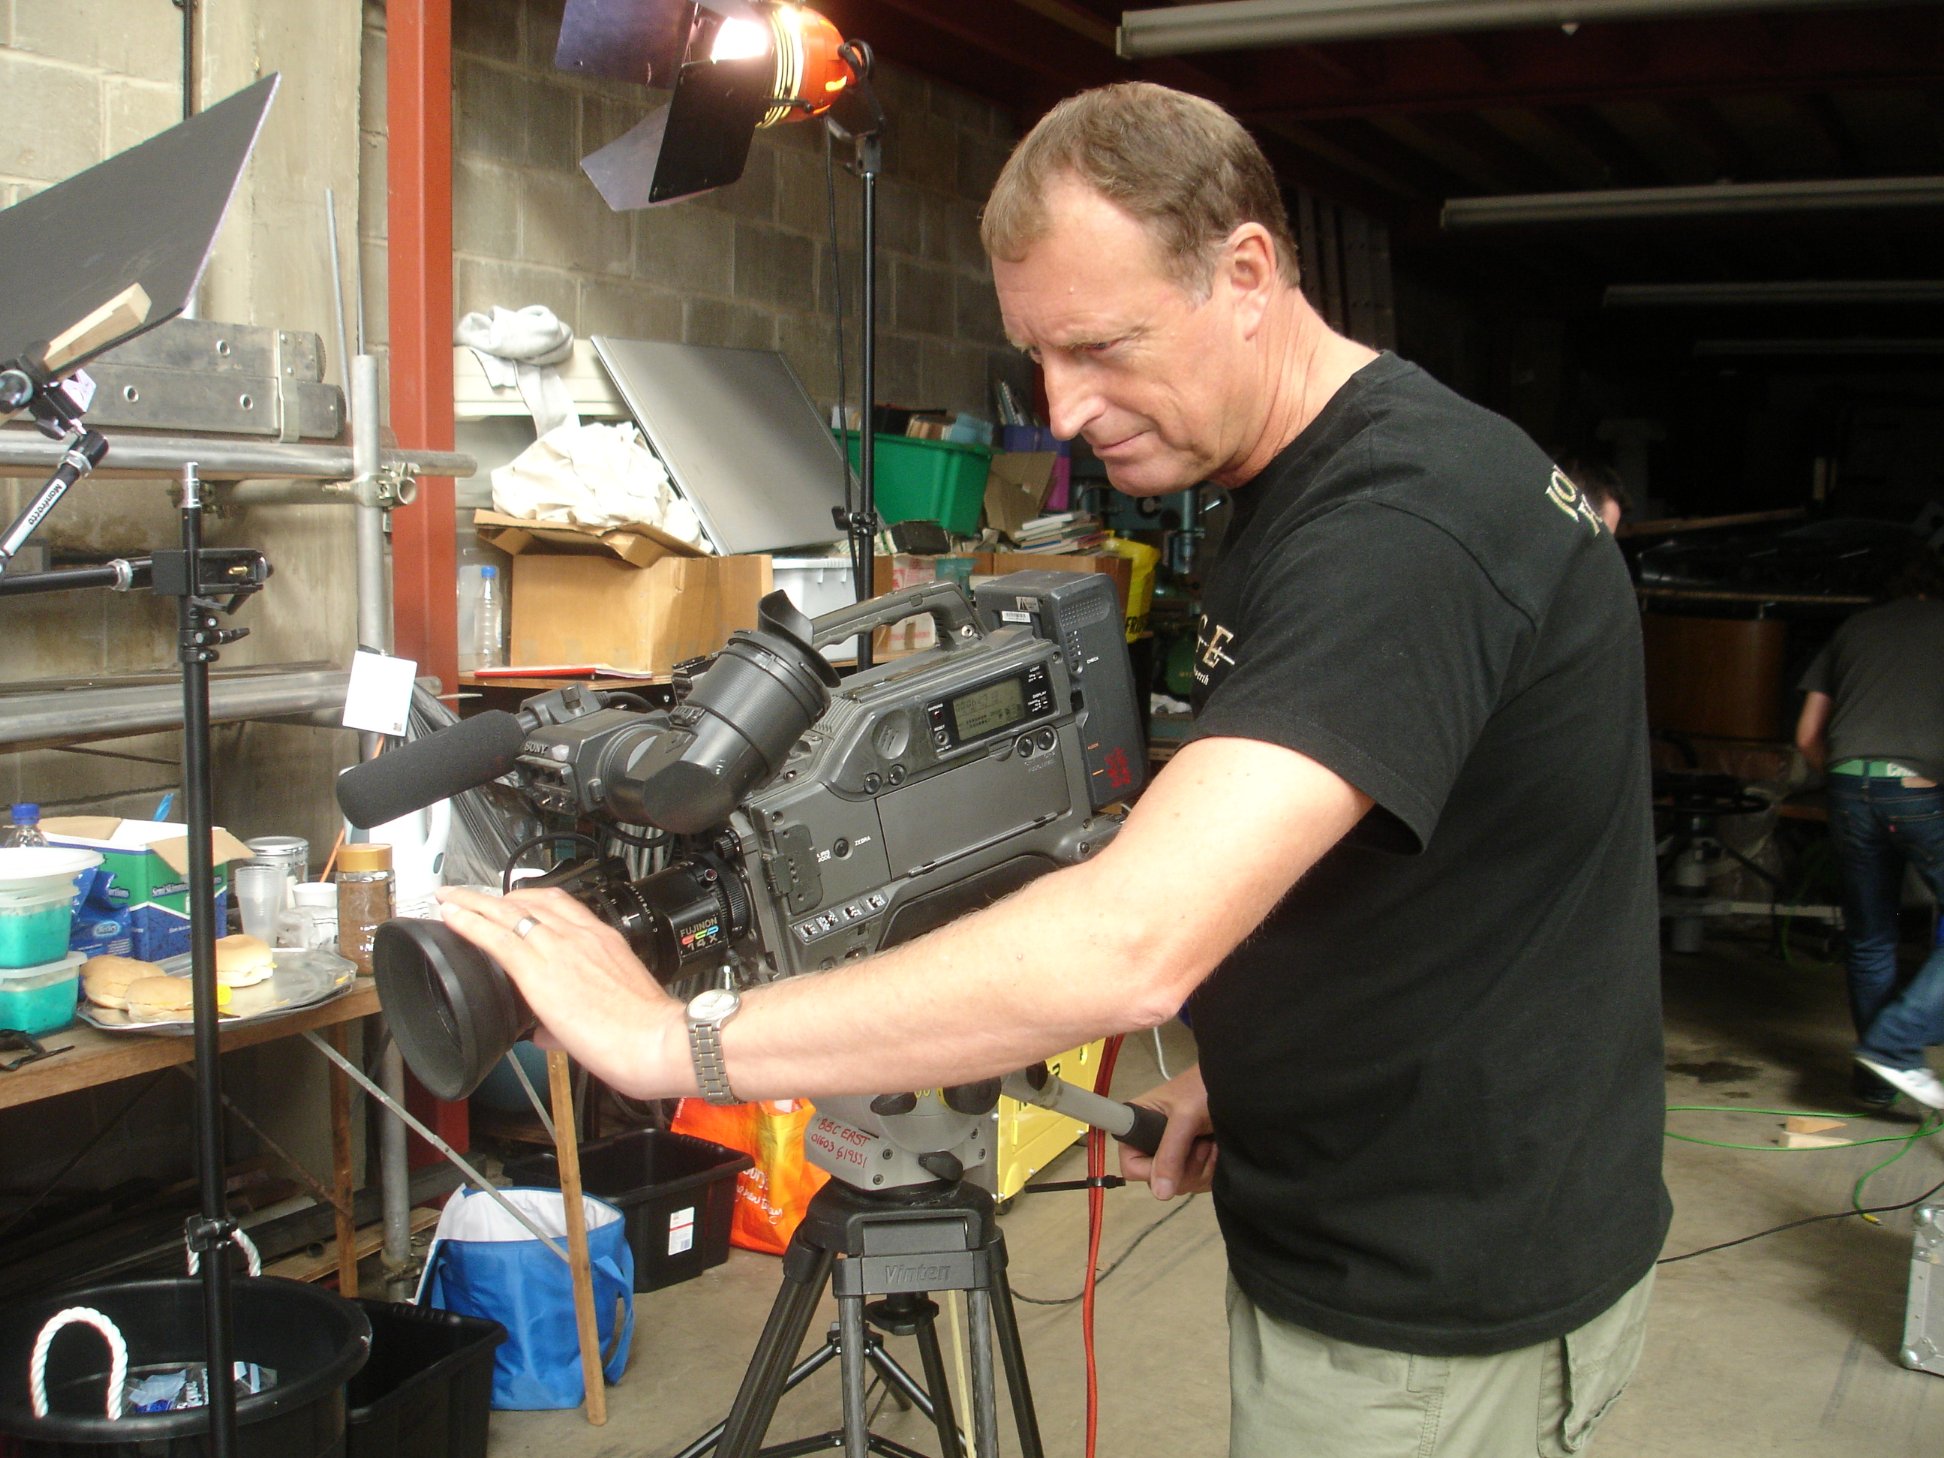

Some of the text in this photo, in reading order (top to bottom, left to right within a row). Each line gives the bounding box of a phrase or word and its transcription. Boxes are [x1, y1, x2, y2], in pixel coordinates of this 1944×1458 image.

[28, 483, 63, 525] Manfrotto
[524, 741, 549, 755] SONY
[680, 917, 718, 937] FUJINON
[818, 1118, 871, 1147] BBC EAST
[885, 1264, 951, 1284] Vinten
